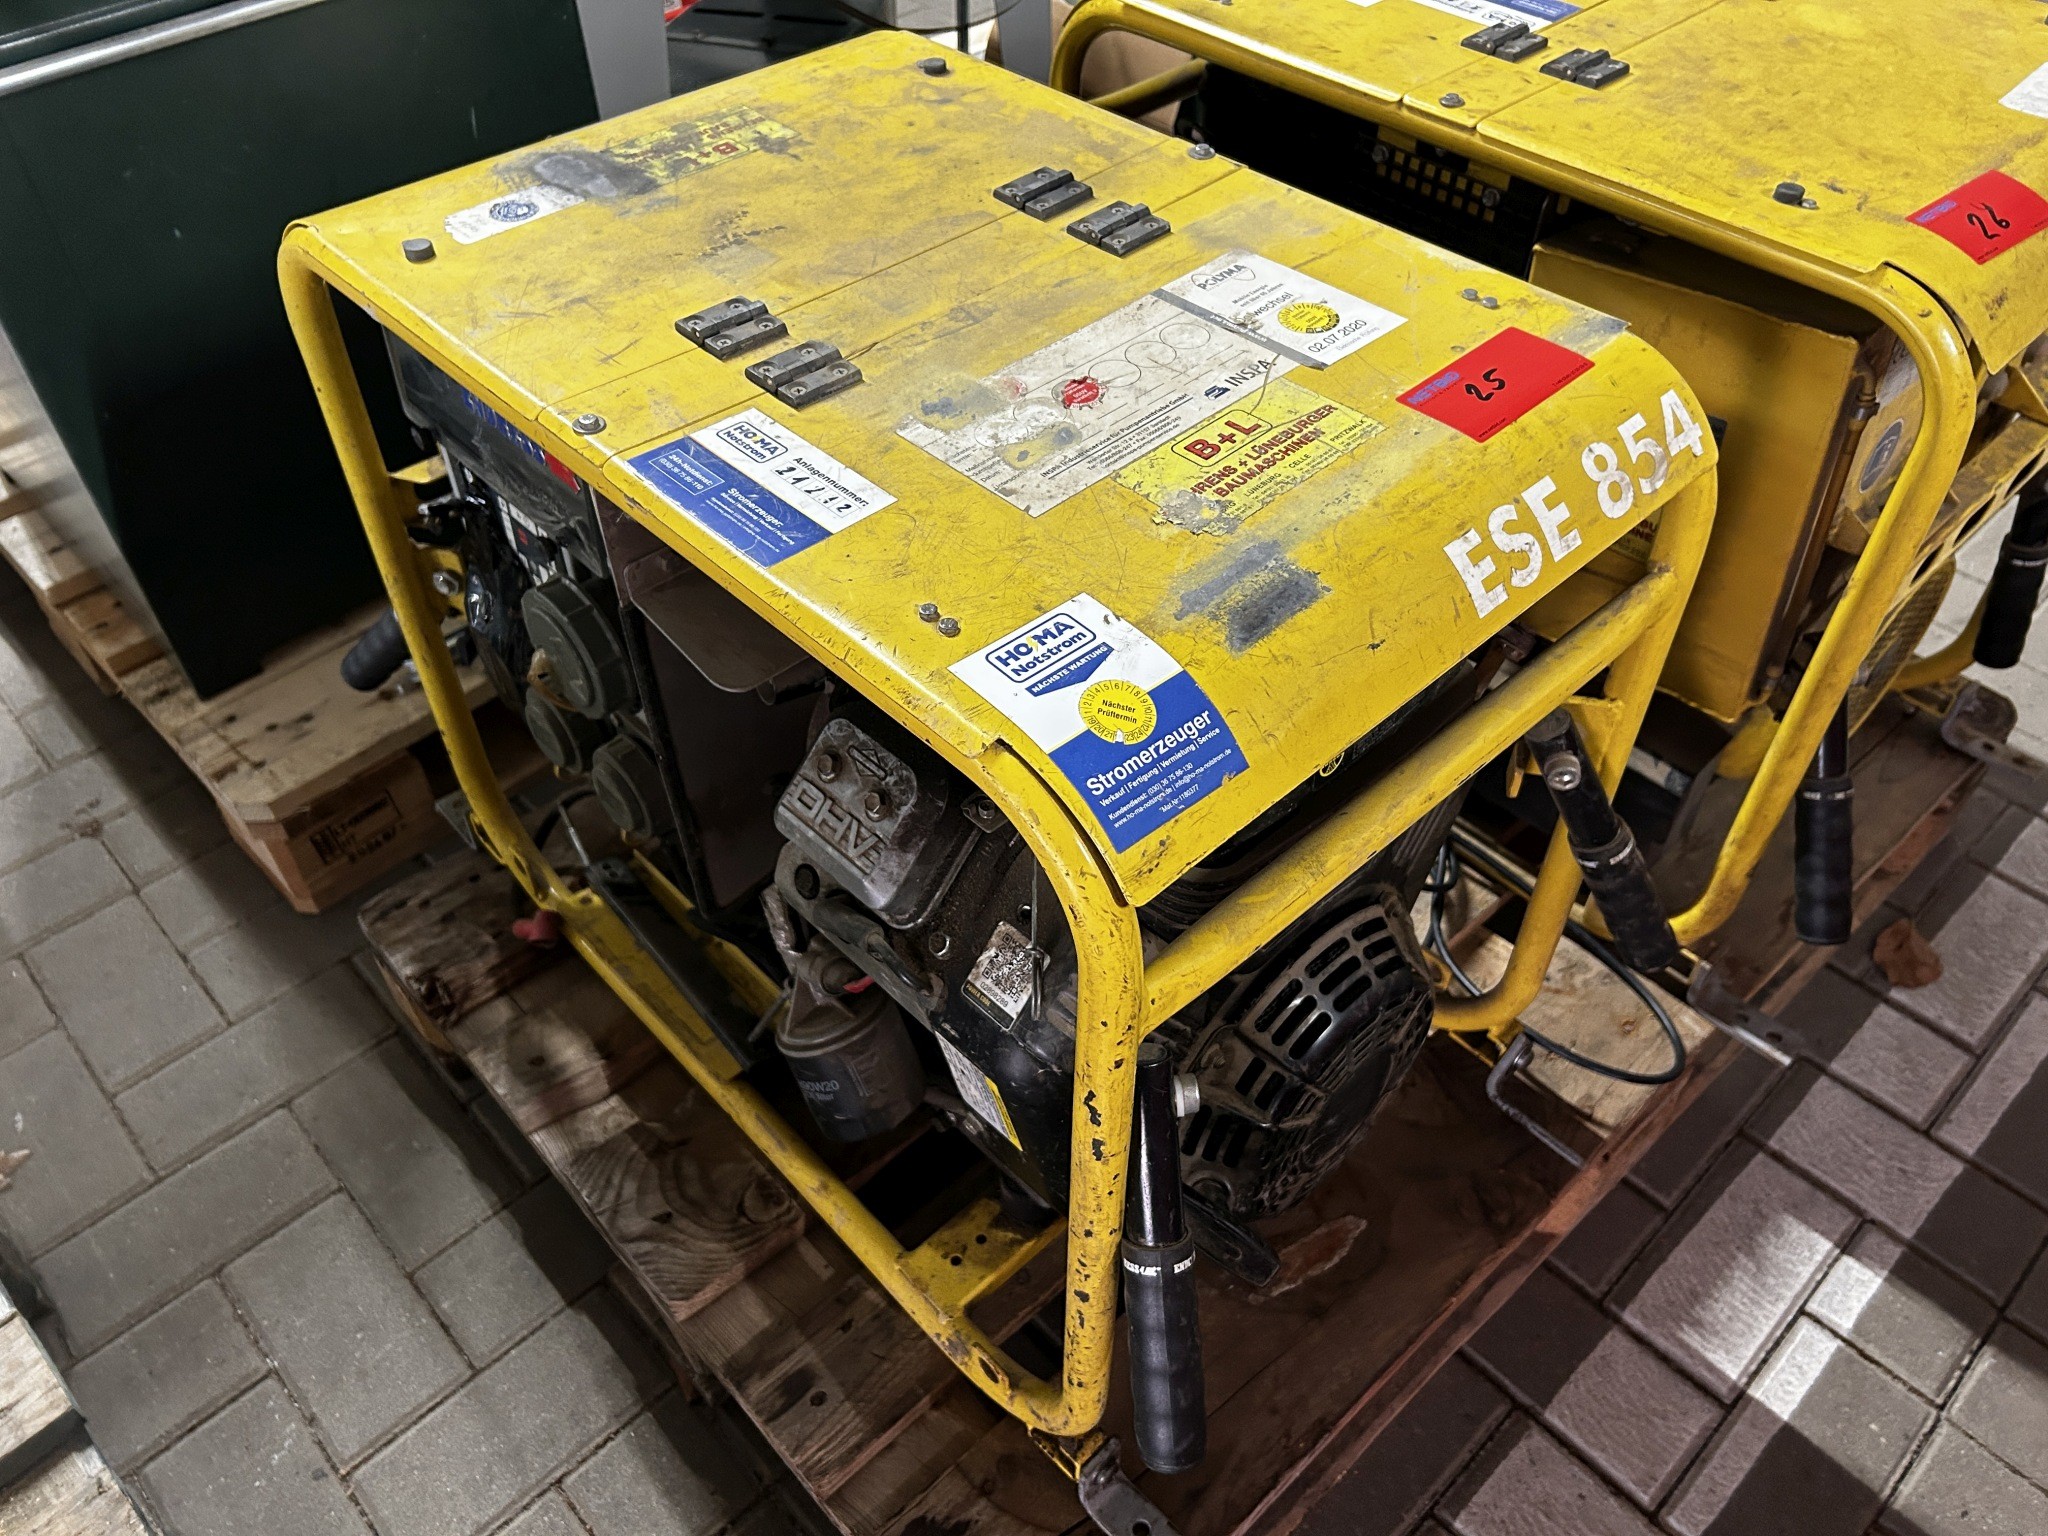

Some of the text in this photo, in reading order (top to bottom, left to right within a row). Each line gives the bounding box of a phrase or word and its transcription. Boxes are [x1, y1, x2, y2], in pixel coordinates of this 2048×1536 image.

[1967, 202, 2010, 240] 26
[1197, 264, 1246, 290] POLYMA
[1222, 358, 1276, 386] INSPA
[1465, 368, 1506, 401] 25
[722, 430, 768, 459] Notstrom
[1058, 436, 1113, 466] Industrieservice
[1108, 430, 1122, 438] für
[1118, 403, 1172, 433] Pumpenantriebe
[1167, 393, 1190, 405] GmbH
[1330, 418, 1368, 445] PRITZWALK
[1190, 465, 1238, 494] HRENS
[1245, 404, 1337, 461] LÜNEBURGER
[1212, 428, 1324, 497] BAUMASCHINEN
[1288, 453, 1312, 469] CELLE
[666, 453, 714, 486] 24h-Notdienst:
[791, 456, 870, 507] Anlagennummer:
[1244, 472, 1282, 497] LÜNEBURG
[1443, 389, 1704, 619] ESE 854
[1011, 631, 1087, 676] Notstrom
[1032, 645, 1108, 694] NÄCHSTE WARTUNG
[1097, 707, 1137, 724] Prüftermin
[1102, 699, 1136, 713] Nächster
[1144, 706, 1152, 714] 10
[1086, 709, 1212, 797] Stromerzeuger
[1099, 728, 1221, 808] Verkauf Fertigung Vermietung Service
[1107, 792, 1151, 820] Kundendienst:
[1166, 772, 1177, 781] 75
[793, 780, 880, 858] OHV
